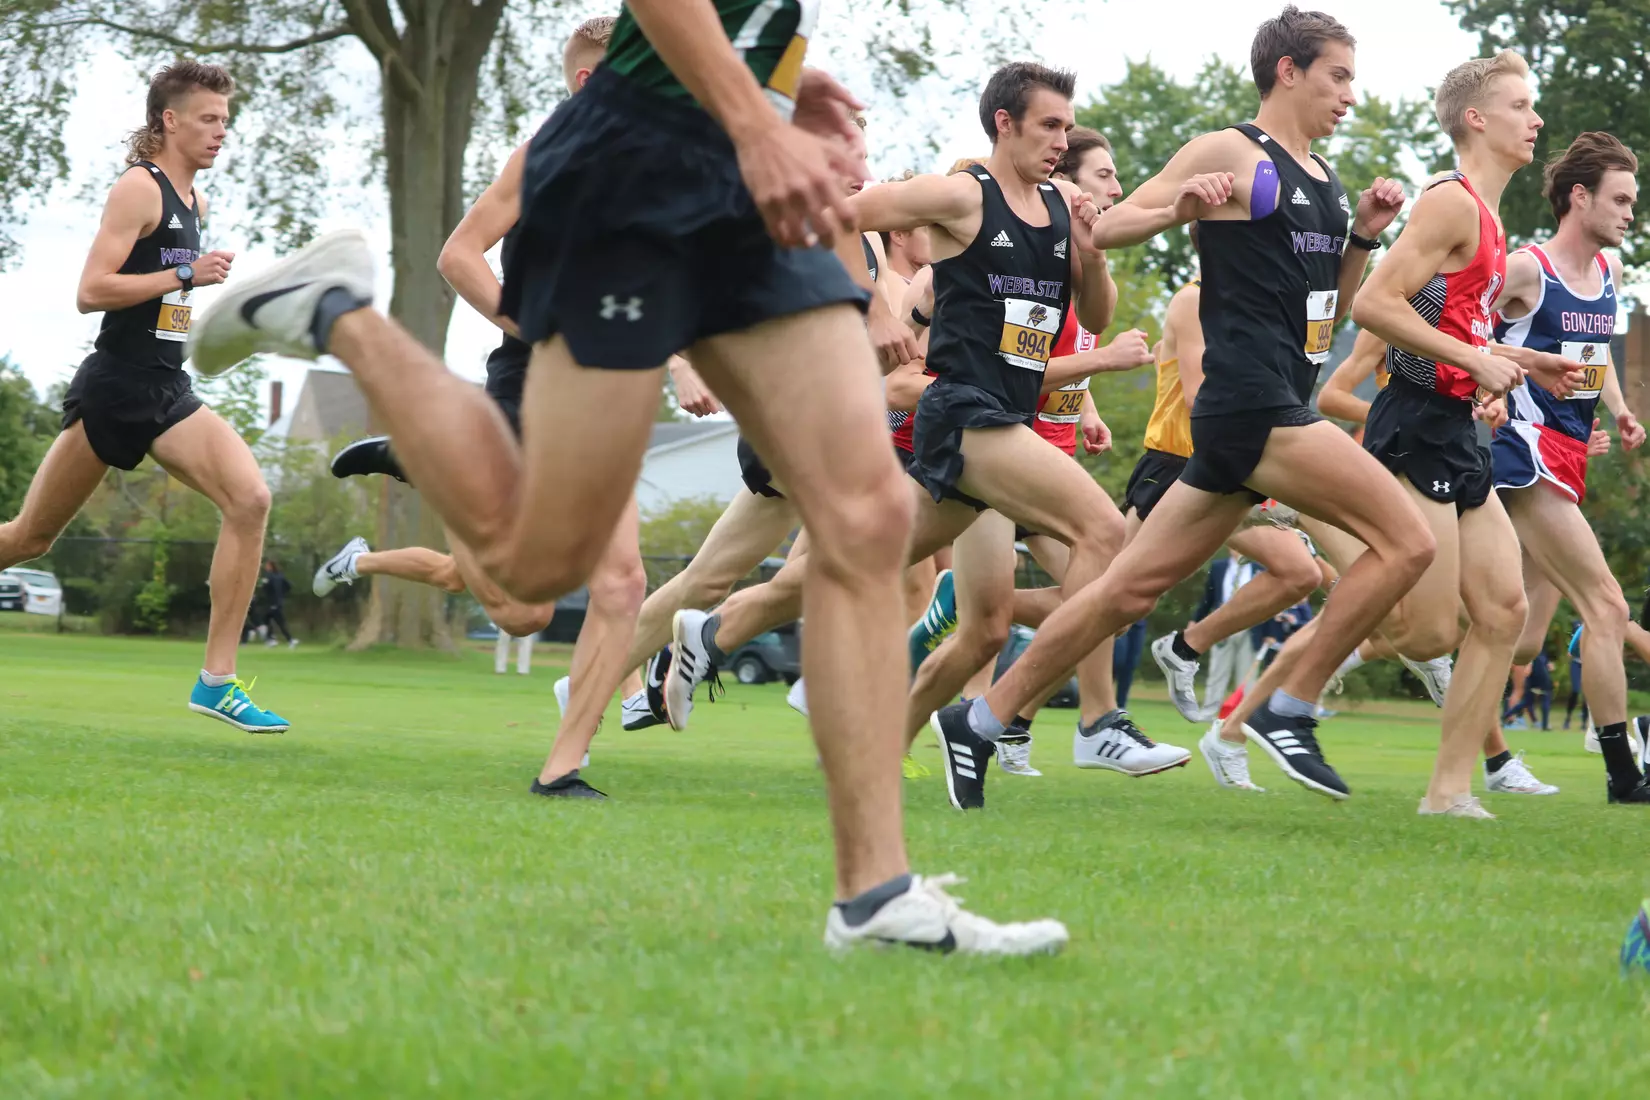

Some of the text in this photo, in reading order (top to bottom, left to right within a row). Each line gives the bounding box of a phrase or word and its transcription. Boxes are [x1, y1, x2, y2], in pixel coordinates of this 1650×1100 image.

[990, 240, 1014, 248] adidas
[1290, 231, 1331, 254] WEBER
[987, 273, 1037, 296] WEBER
[171, 309, 191, 330] 992
[1561, 311, 1614, 336] GONZAGA
[1016, 330, 1047, 359] 994
[1057, 392, 1084, 413] 242
